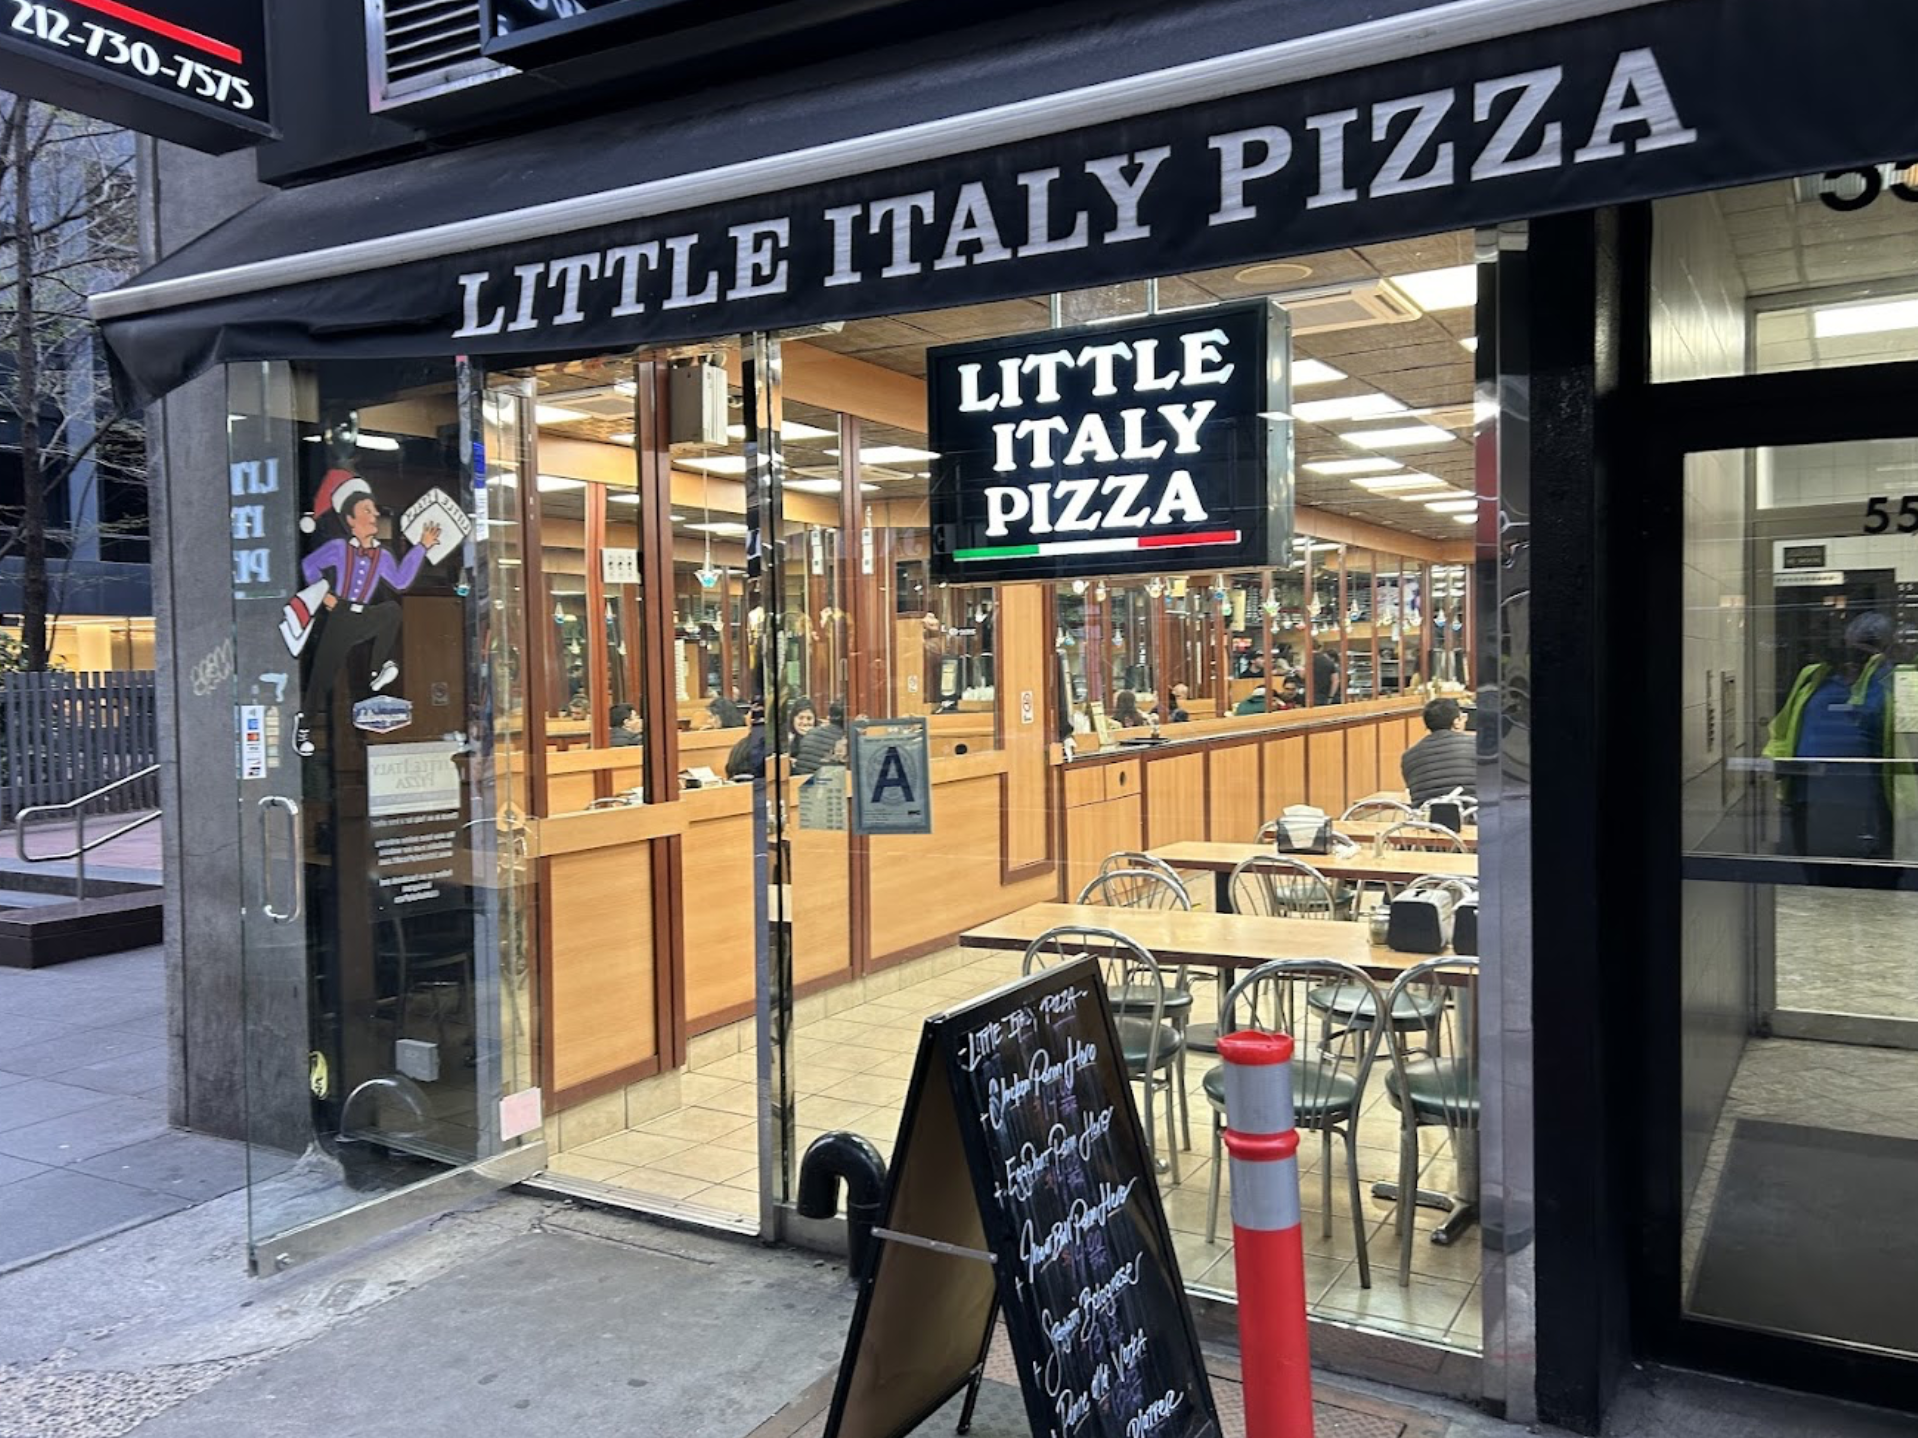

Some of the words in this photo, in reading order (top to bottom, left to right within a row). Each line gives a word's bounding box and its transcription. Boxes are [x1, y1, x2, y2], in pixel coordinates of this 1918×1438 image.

[11, 0, 254, 110] 212-730-7575
[452, 217, 789, 338] LITTLE
[823, 145, 1170, 287] ITALY
[1208, 46, 1697, 226] PIZZA
[957, 328, 1235, 413] LITTLE
[992, 400, 1217, 472] ITALY
[984, 469, 1208, 537] PIZZA
[870, 746, 916, 804] A
